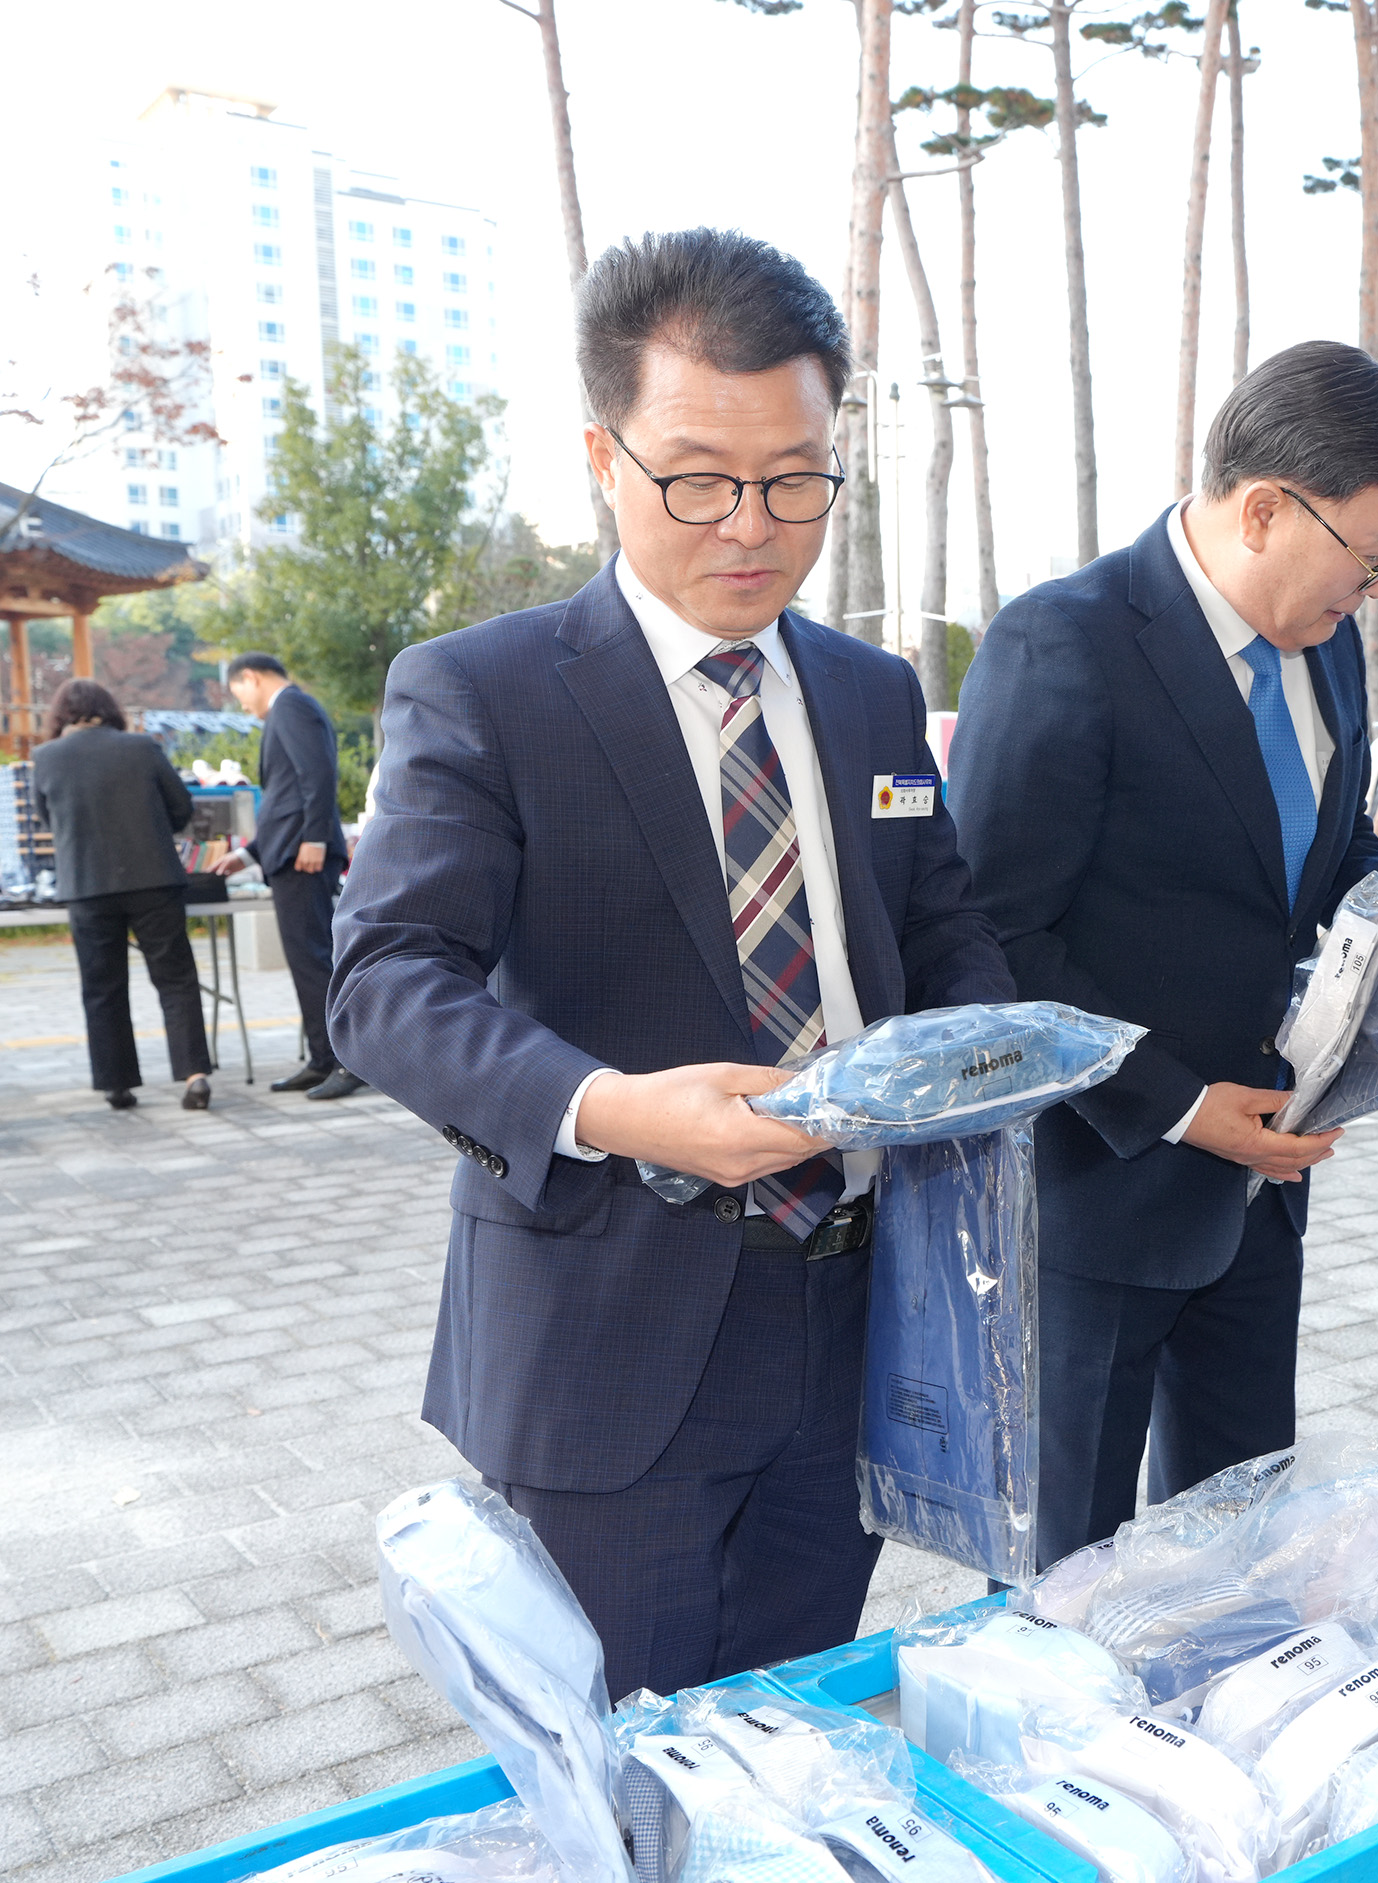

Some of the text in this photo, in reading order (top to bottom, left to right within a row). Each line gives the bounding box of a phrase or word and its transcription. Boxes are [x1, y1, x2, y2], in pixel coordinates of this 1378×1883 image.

[1352, 954, 1364, 971] 105
[961, 1048, 1024, 1081] renoma
[1270, 1635, 1322, 1670] renoma
[1304, 1656, 1322, 1671] 95
[699, 1738, 713, 1751] 95
[1129, 1715, 1186, 1749] renoma
[1055, 1778, 1110, 1811] renoma
[1043, 1801, 1062, 1817] 95
[866, 1815, 916, 1863] renoma
[901, 1818, 922, 1836] 95
